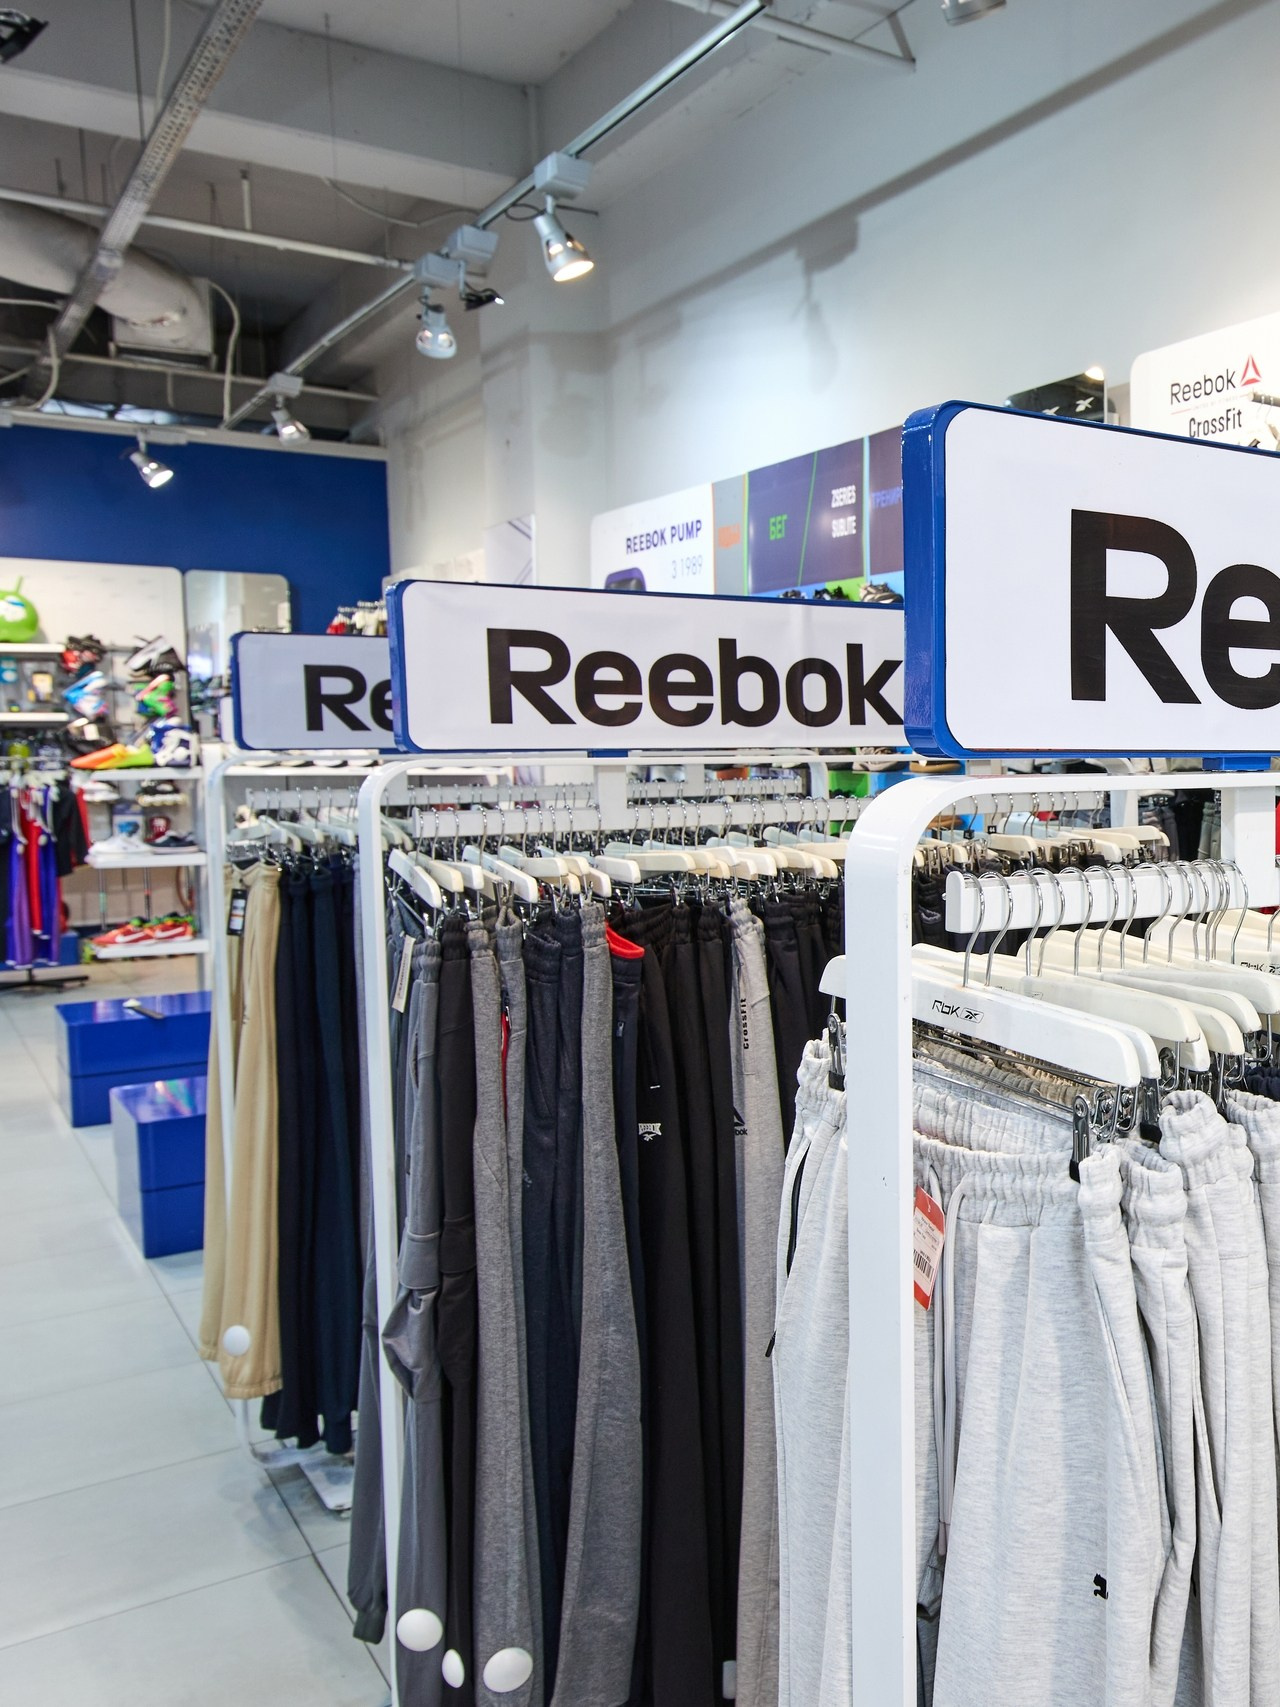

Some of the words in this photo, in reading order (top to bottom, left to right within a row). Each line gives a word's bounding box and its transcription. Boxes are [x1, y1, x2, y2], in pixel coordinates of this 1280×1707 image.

[1170, 368, 1236, 406] Reebok
[1188, 408, 1242, 438] CrossFit
[626, 528, 667, 555] REEBOK
[670, 519, 702, 543] PUMP
[769, 514, 788, 541] БЕГ
[832, 515, 857, 538] SUBLITE
[681, 554, 703, 577] 1989
[486, 627, 904, 728] Reebok
[740, 997, 750, 1050] CrossFit
